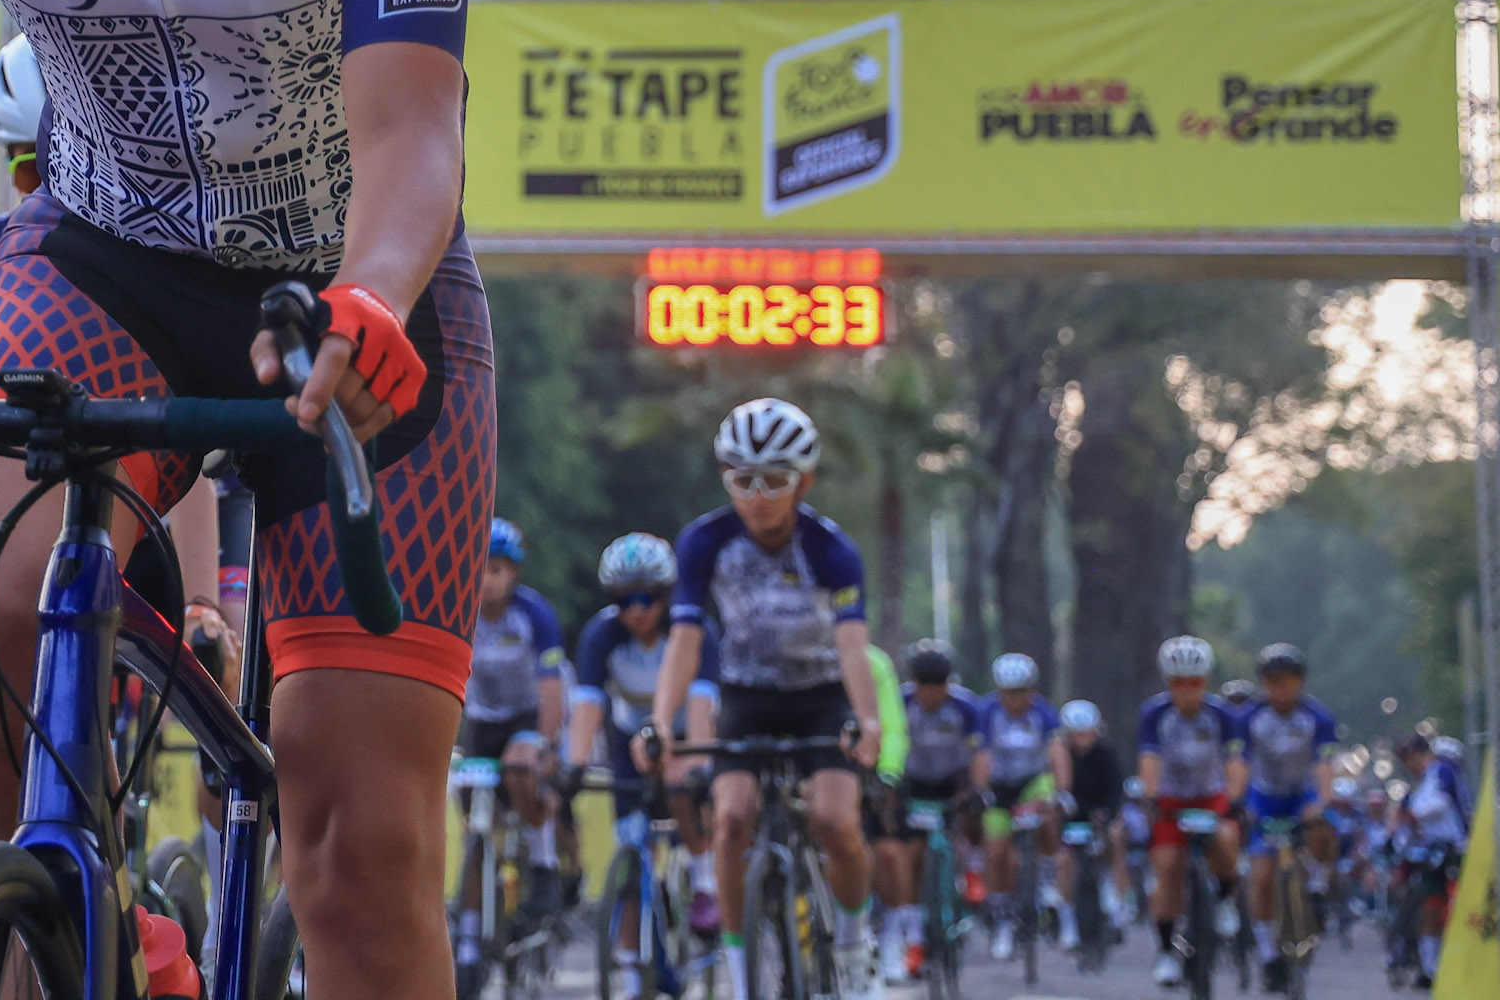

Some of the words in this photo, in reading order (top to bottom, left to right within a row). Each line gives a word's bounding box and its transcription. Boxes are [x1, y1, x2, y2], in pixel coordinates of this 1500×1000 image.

[1222, 75, 1376, 108] Pensar
[980, 110, 1157, 139] PUEBLA
[648, 284, 881, 345] 00:02:33
[3, 374, 45, 383] GARMIN
[236, 804, 251, 817] 58
